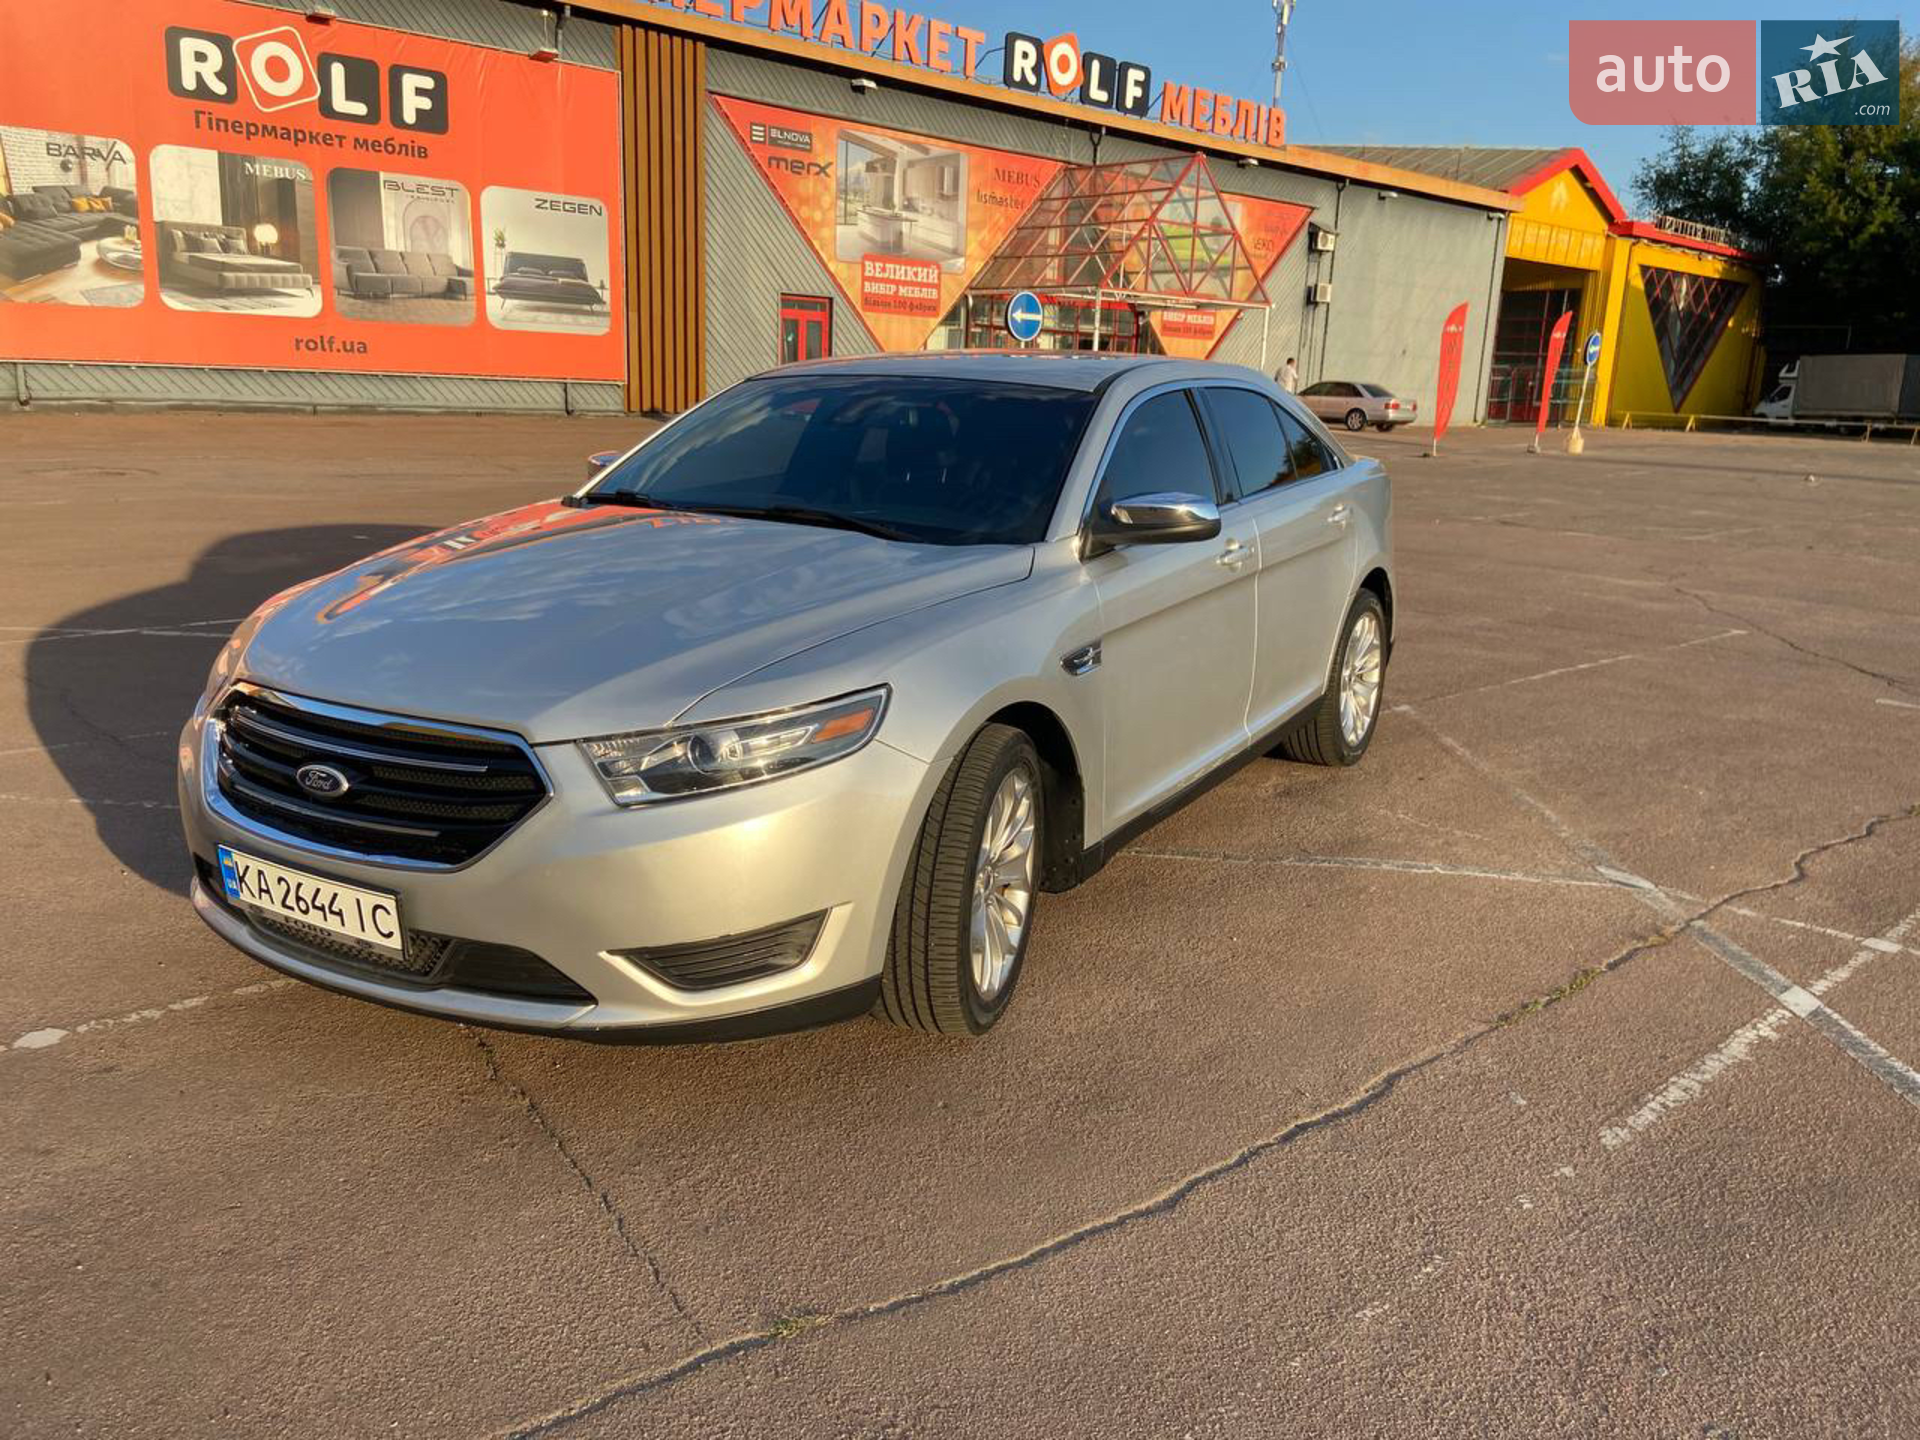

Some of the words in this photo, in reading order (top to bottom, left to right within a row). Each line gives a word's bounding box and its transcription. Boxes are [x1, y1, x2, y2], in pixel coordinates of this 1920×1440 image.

[179, 36, 436, 125] ROLF
[1012, 38, 1146, 110] ROLF
[1160, 81, 1287, 147] МЕБЛІВ
[193, 109, 347, 149] Гіпермаркет
[353, 136, 429, 159] меблів
[244, 161, 307, 180] MEBUS
[767, 155, 834, 178] merx
[383, 179, 460, 198] BLEST
[534, 197, 603, 217] ZEGEN
[863, 260, 938, 284] ВЕЛИКИЙ
[863, 281, 897, 296] ВИБІР
[898, 285, 938, 300] МЕБЛІВ
[294, 335, 367, 354] rolf.ua
[305, 769, 334, 791] Ford
